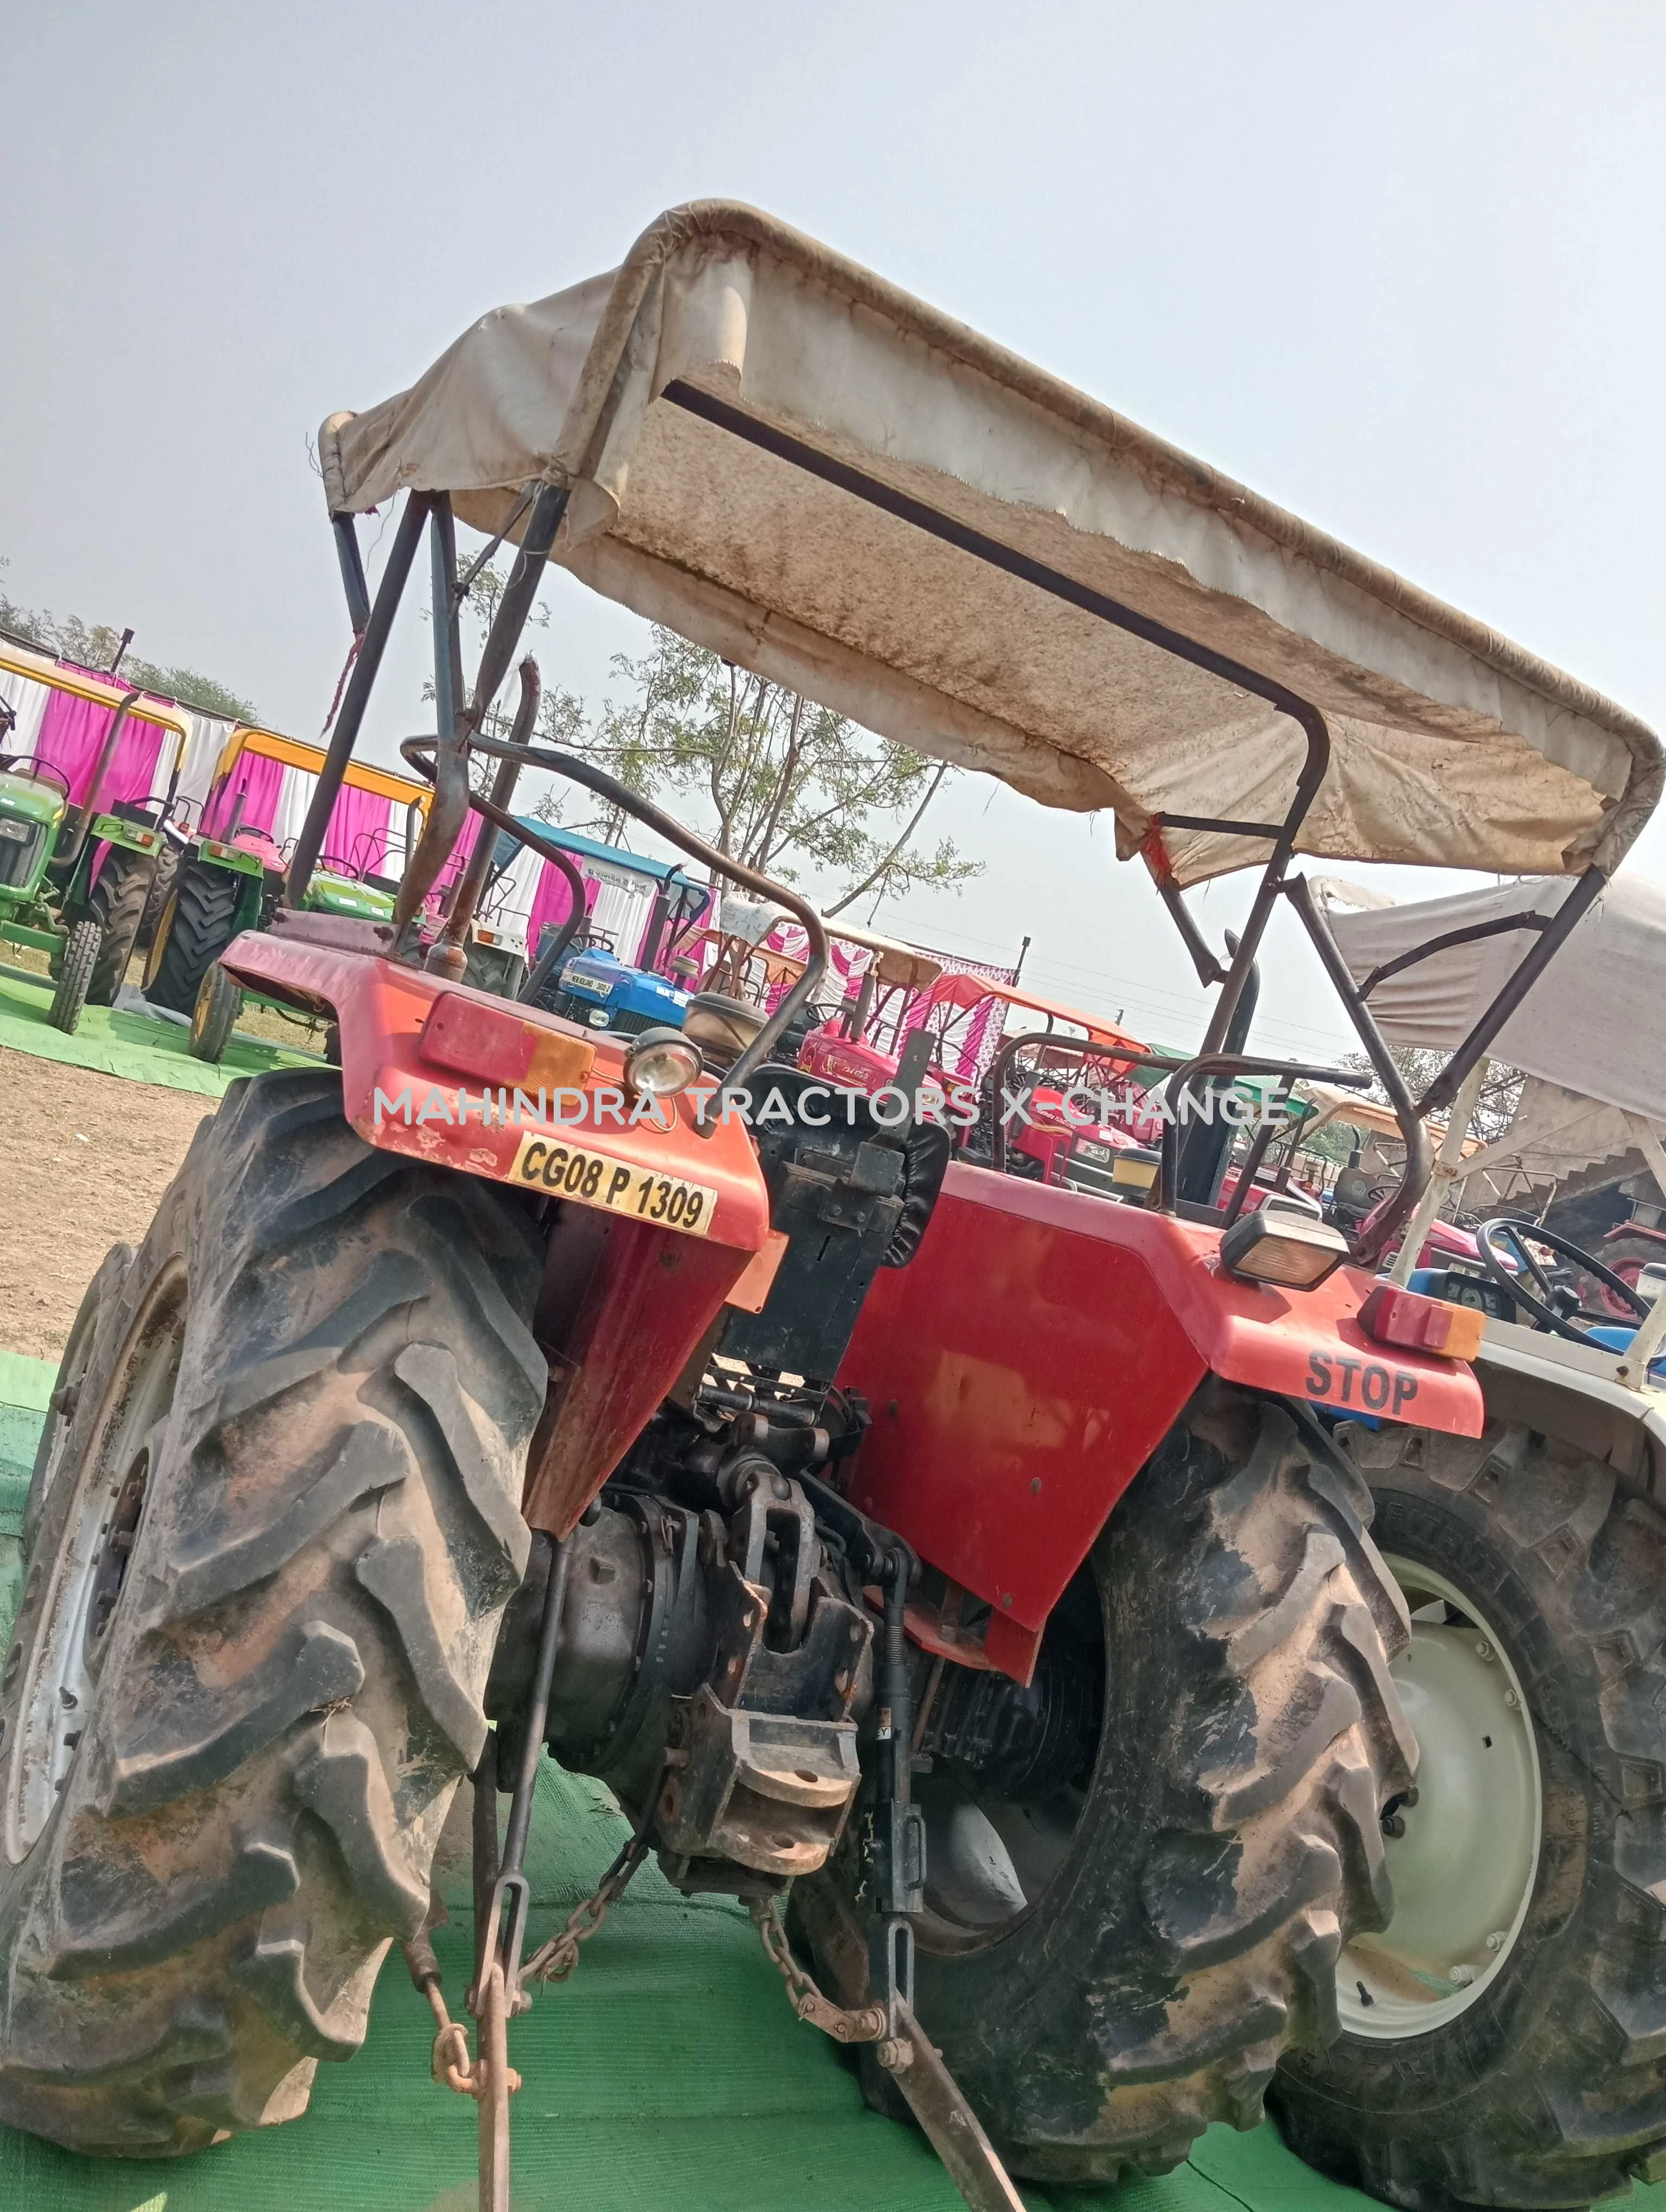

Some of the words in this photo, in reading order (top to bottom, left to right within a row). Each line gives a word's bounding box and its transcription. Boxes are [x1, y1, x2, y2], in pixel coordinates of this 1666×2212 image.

[522, 1142, 605, 1198] CG08
[607, 1167, 633, 1205] P
[638, 1175, 704, 1228] 1309
[1304, 1349, 1418, 1416] STOP
